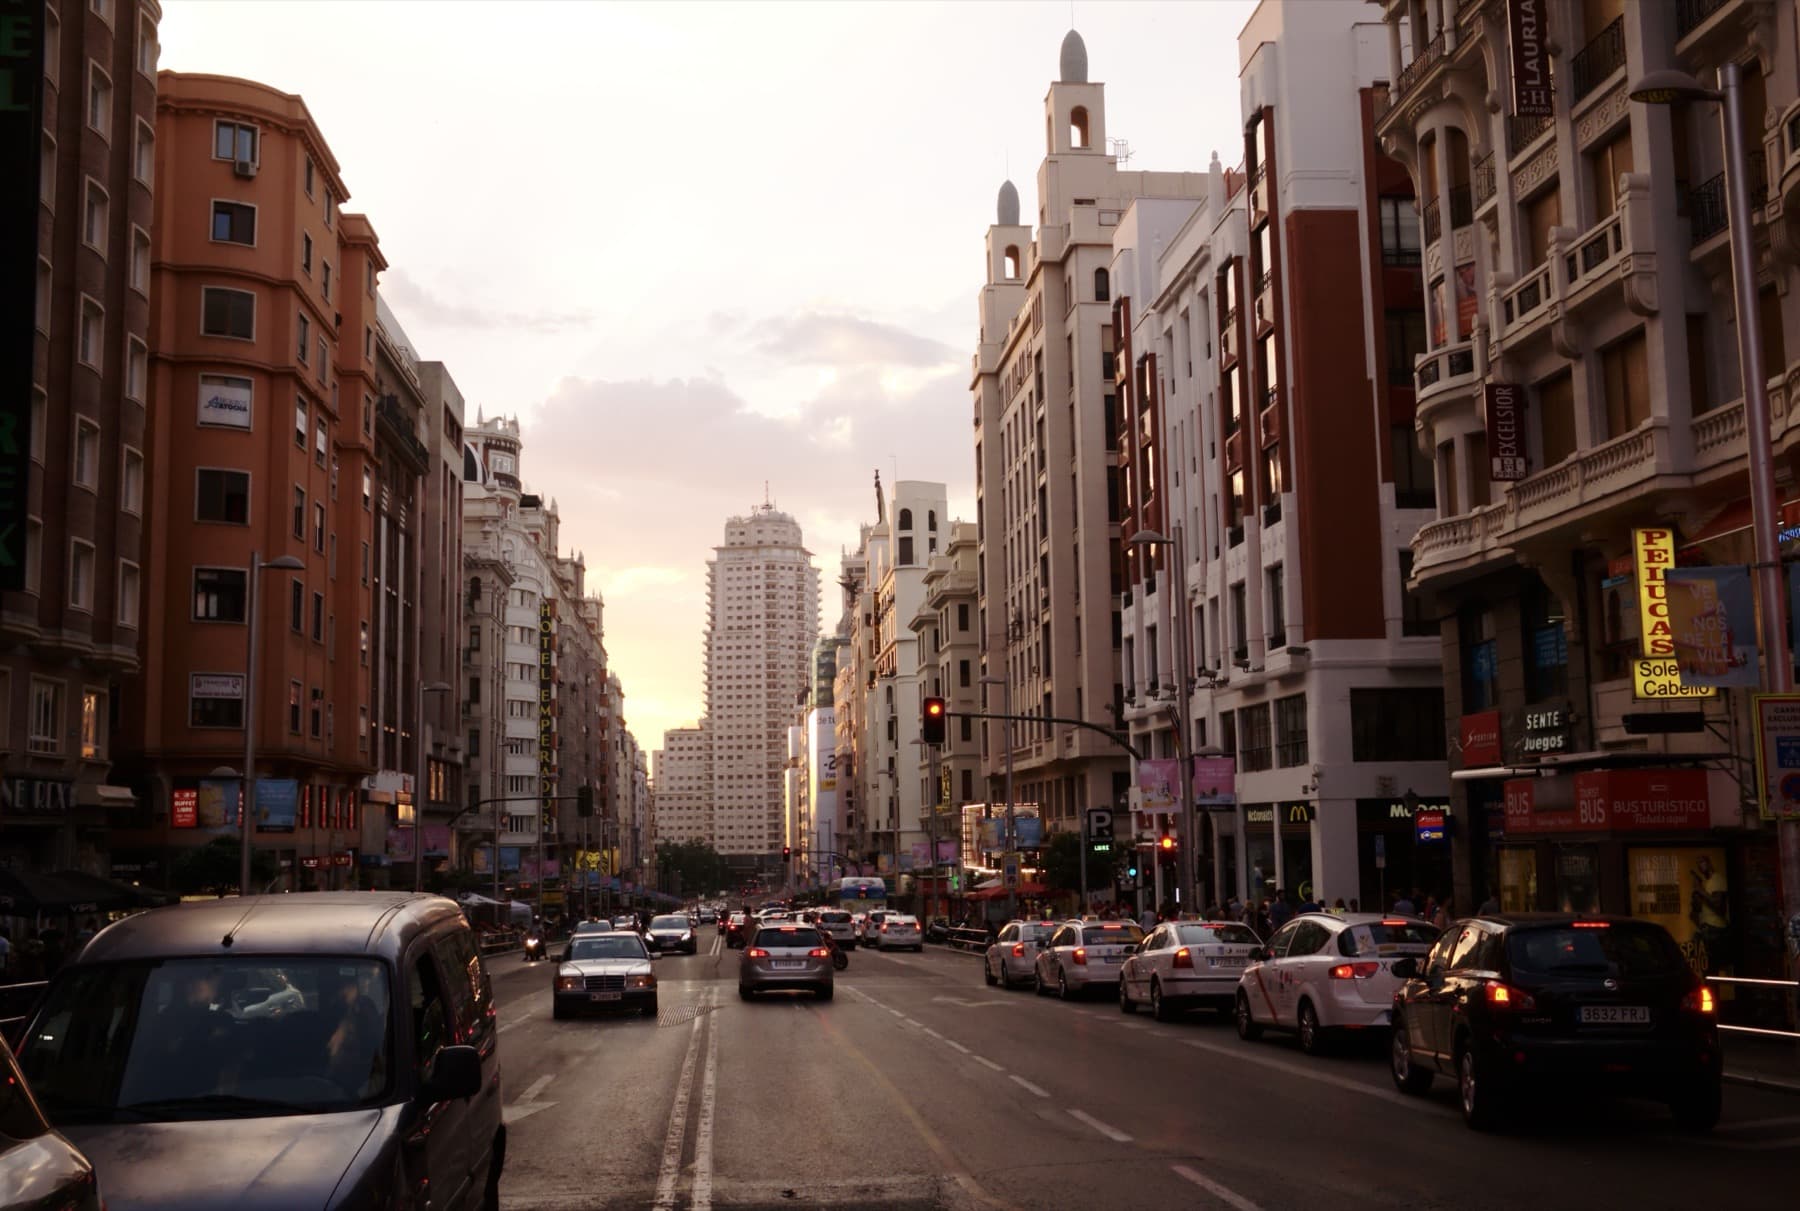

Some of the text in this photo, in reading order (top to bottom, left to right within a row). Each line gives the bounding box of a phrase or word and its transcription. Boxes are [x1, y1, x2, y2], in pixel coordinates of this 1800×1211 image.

[1521, 0, 1541, 86] LAURIA
[1496, 386, 1518, 458] EXCELSIOR
[1642, 530, 1675, 655] PELUCAS
[1692, 616, 1728, 632] NOS
[539, 604, 551, 826] HOTEL EMPERADOR
[1526, 711, 1560, 730] SENTE
[1524, 735, 1564, 751] Juegos
[1507, 791, 1529, 816] BUS
[1580, 798, 1606, 825] BUS
[1090, 811, 1111, 837] P
[1621, 1009, 1647, 1021] FRJ
